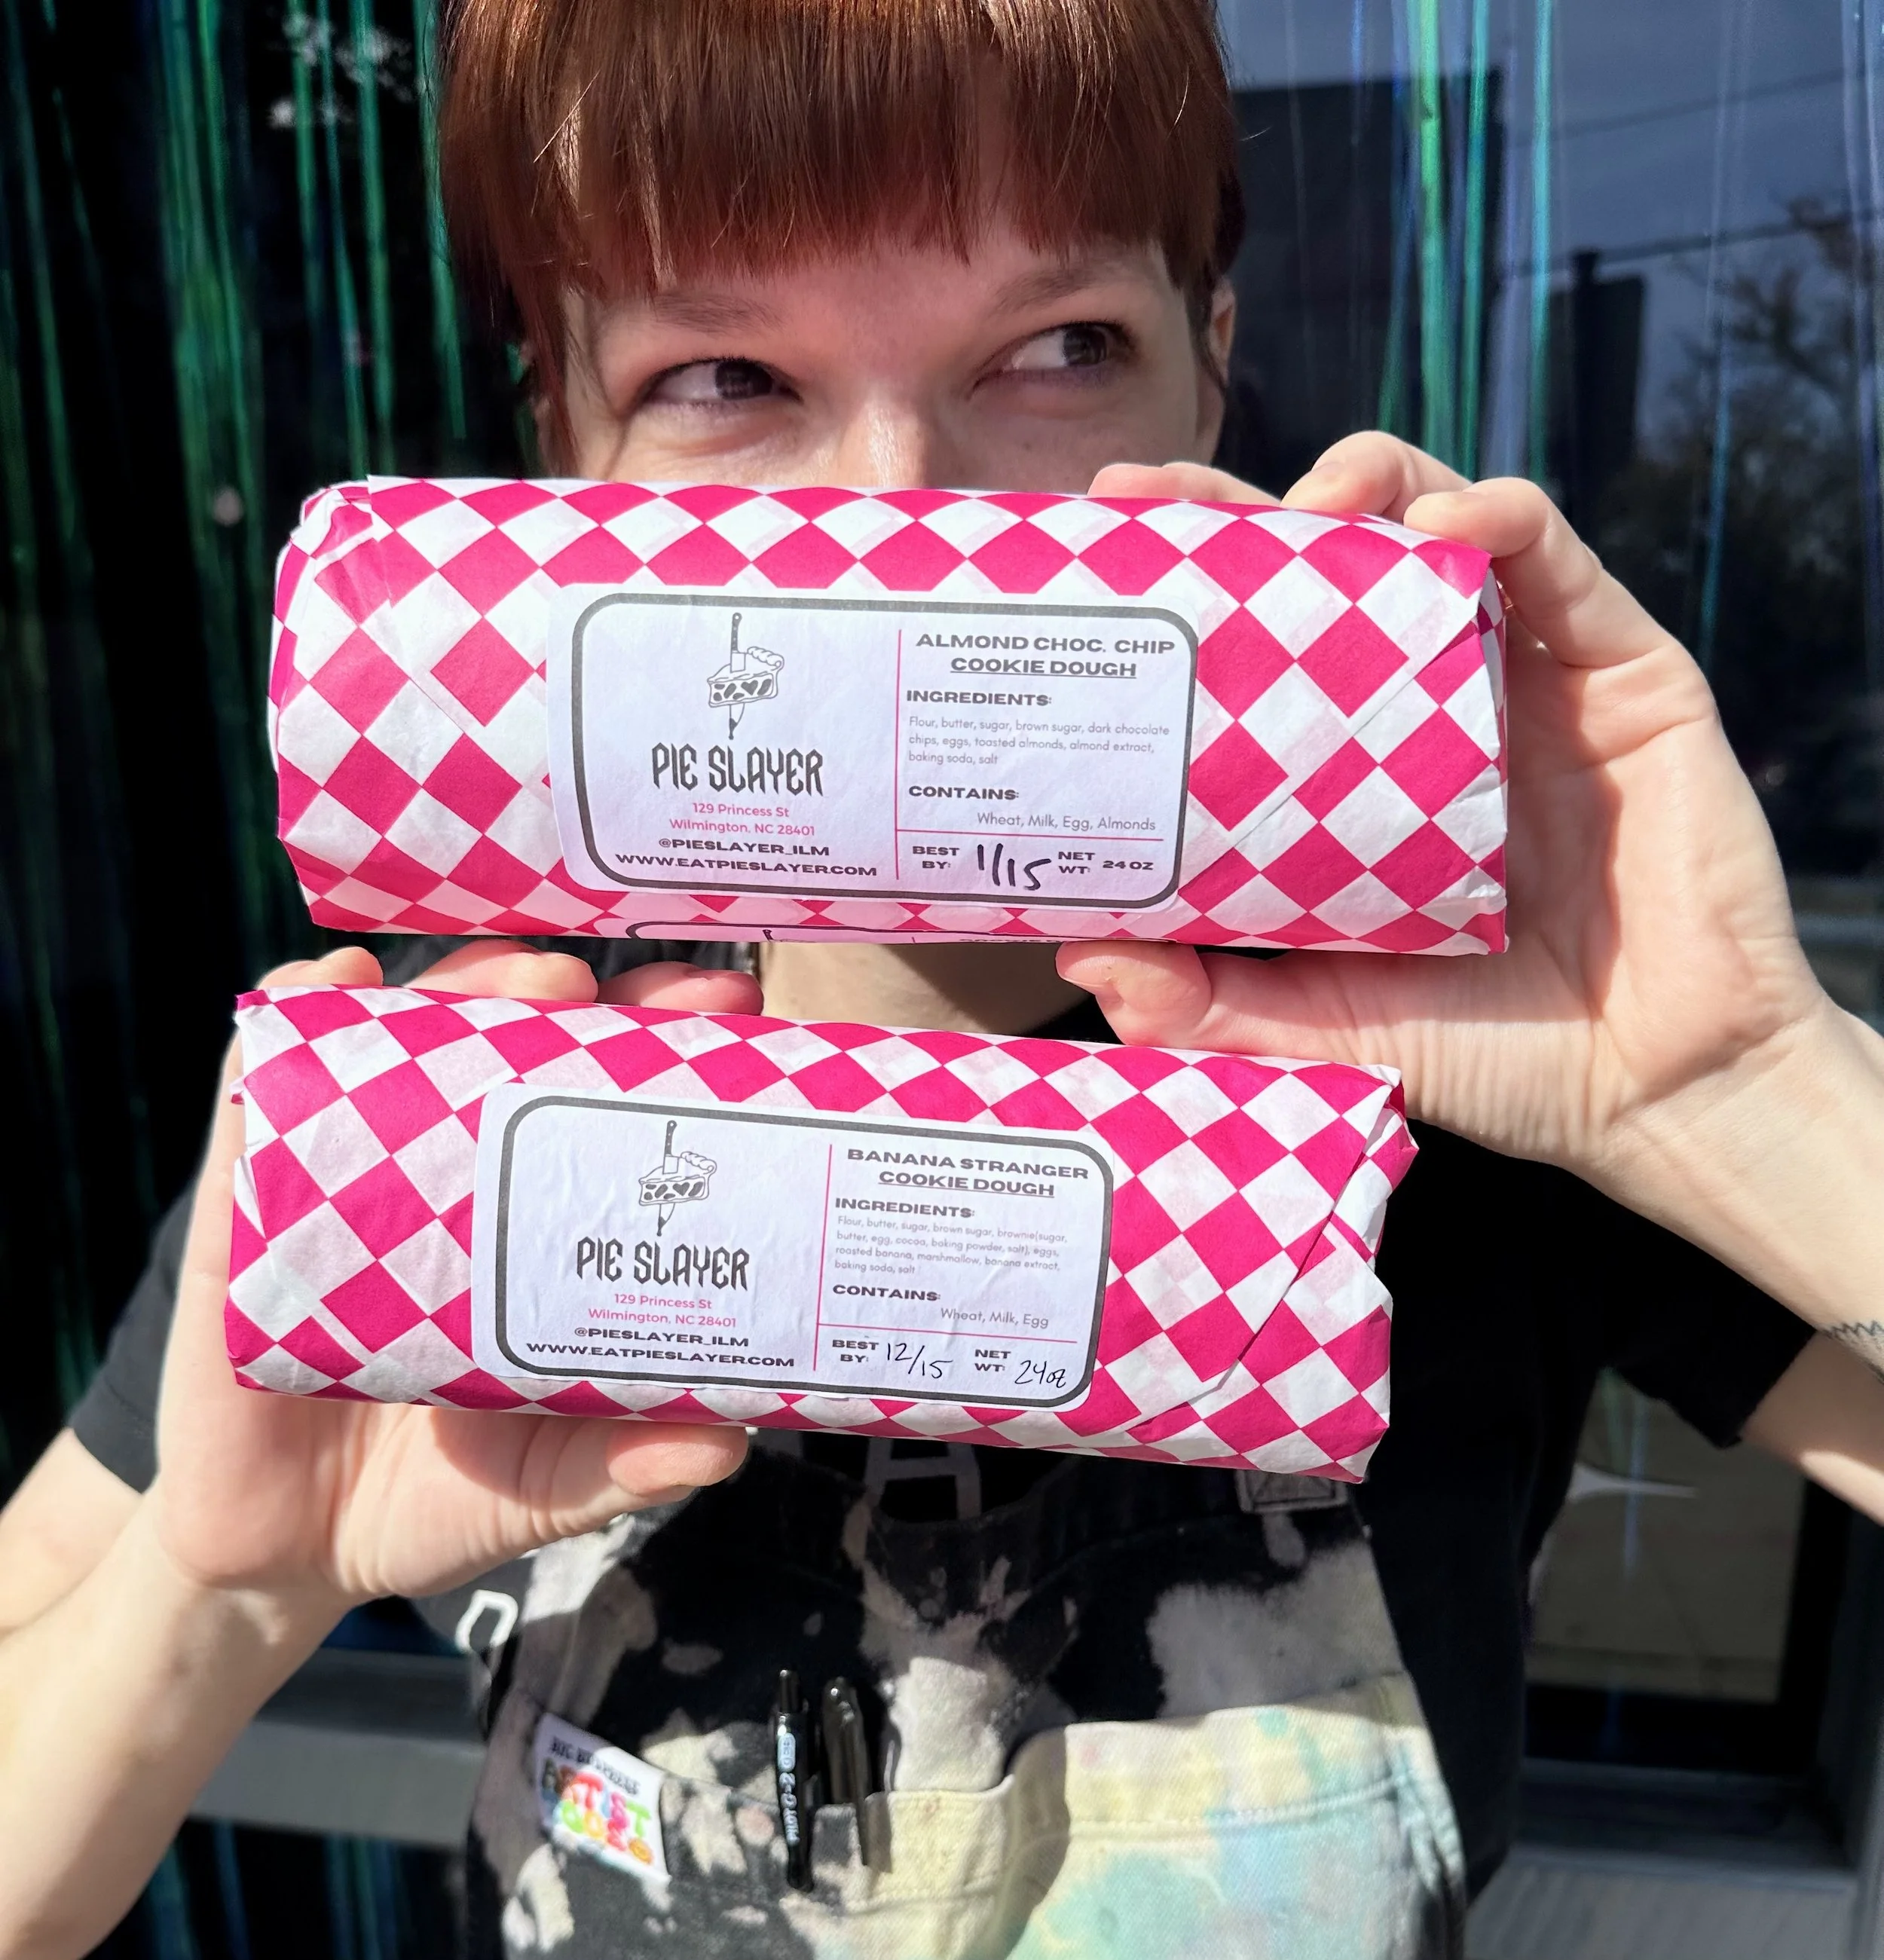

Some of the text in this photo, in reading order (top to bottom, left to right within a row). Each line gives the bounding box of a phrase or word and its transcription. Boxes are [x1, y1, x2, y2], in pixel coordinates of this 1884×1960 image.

[916, 634, 1175, 654] ALMOND CHOC. CHIP
[950, 658, 1136, 676] COOKIE DOUGH
[907, 690, 1052, 705] INGREDIENTS:
[910, 716, 1170, 735] Flour, butter, sugar, brown sugar, dark chocolate
[909, 734, 1154, 753] chips, eggs, toasted almonds, almond extract,
[909, 751, 998, 765] baking soda, salt
[652, 742, 824, 797] PIE SLAYER
[909, 786, 1019, 800] CONTAINS:
[693, 803, 789, 817] 129 Princess St
[755, 824, 773, 833] NC
[778, 825, 815, 836] 28401
[977, 812, 1155, 832] Wheat, Milk, Egg, Almonds
[659, 838, 829, 856] @PIESLAYER_ILM
[913, 846, 959, 856] BEST
[1058, 852, 1095, 861] NET
[616, 854, 876, 876] WWW.EATPIESLAYER.COM
[922, 861, 951, 869] BY:
[977, 843, 1051, 891] 1/15
[848, 1149, 1088, 1179] BANANA STRANGER
[879, 1171, 1054, 1196] COOKIE DOUGH
[835, 1198, 975, 1218] INGREDIENTS:
[838, 1216, 864, 1228] Flour,
[867, 1218, 898, 1229] butter,
[901, 1223, 930, 1233] sugar,
[933, 1222, 963, 1234] brown
[965, 1228, 994, 1237] sugar,
[837, 1231, 868, 1243] butter,
[871, 1235, 893, 1246] egg,
[896, 1237, 928, 1246] cocoa,
[931, 1238, 963, 1252] baking
[966, 1240, 1005, 1252] powder,
[577, 1237, 750, 1291] PIE SLAYER
[835, 1260, 867, 1273] baking
[870, 1264, 895, 1274] soda,
[836, 1247, 1060, 1271] roasted banana, marshmallow, banana extract,
[614, 1294, 711, 1309] 129 Princess St
[833, 1285, 940, 1301] CONTAINS:
[589, 1309, 736, 1327] Wilmington, NC 28401
[941, 1307, 1048, 1329] Wheat, Milk, Egg
[574, 1327, 748, 1347] @PIESLAYER_ILM
[832, 1339, 879, 1350] BEST
[527, 1344, 794, 1367] WWW.EATPIESLAYER.COM
[840, 1354, 869, 1362] BY:
[887, 1343, 953, 1378] 12/15
[974, 1350, 1011, 1359] NET
